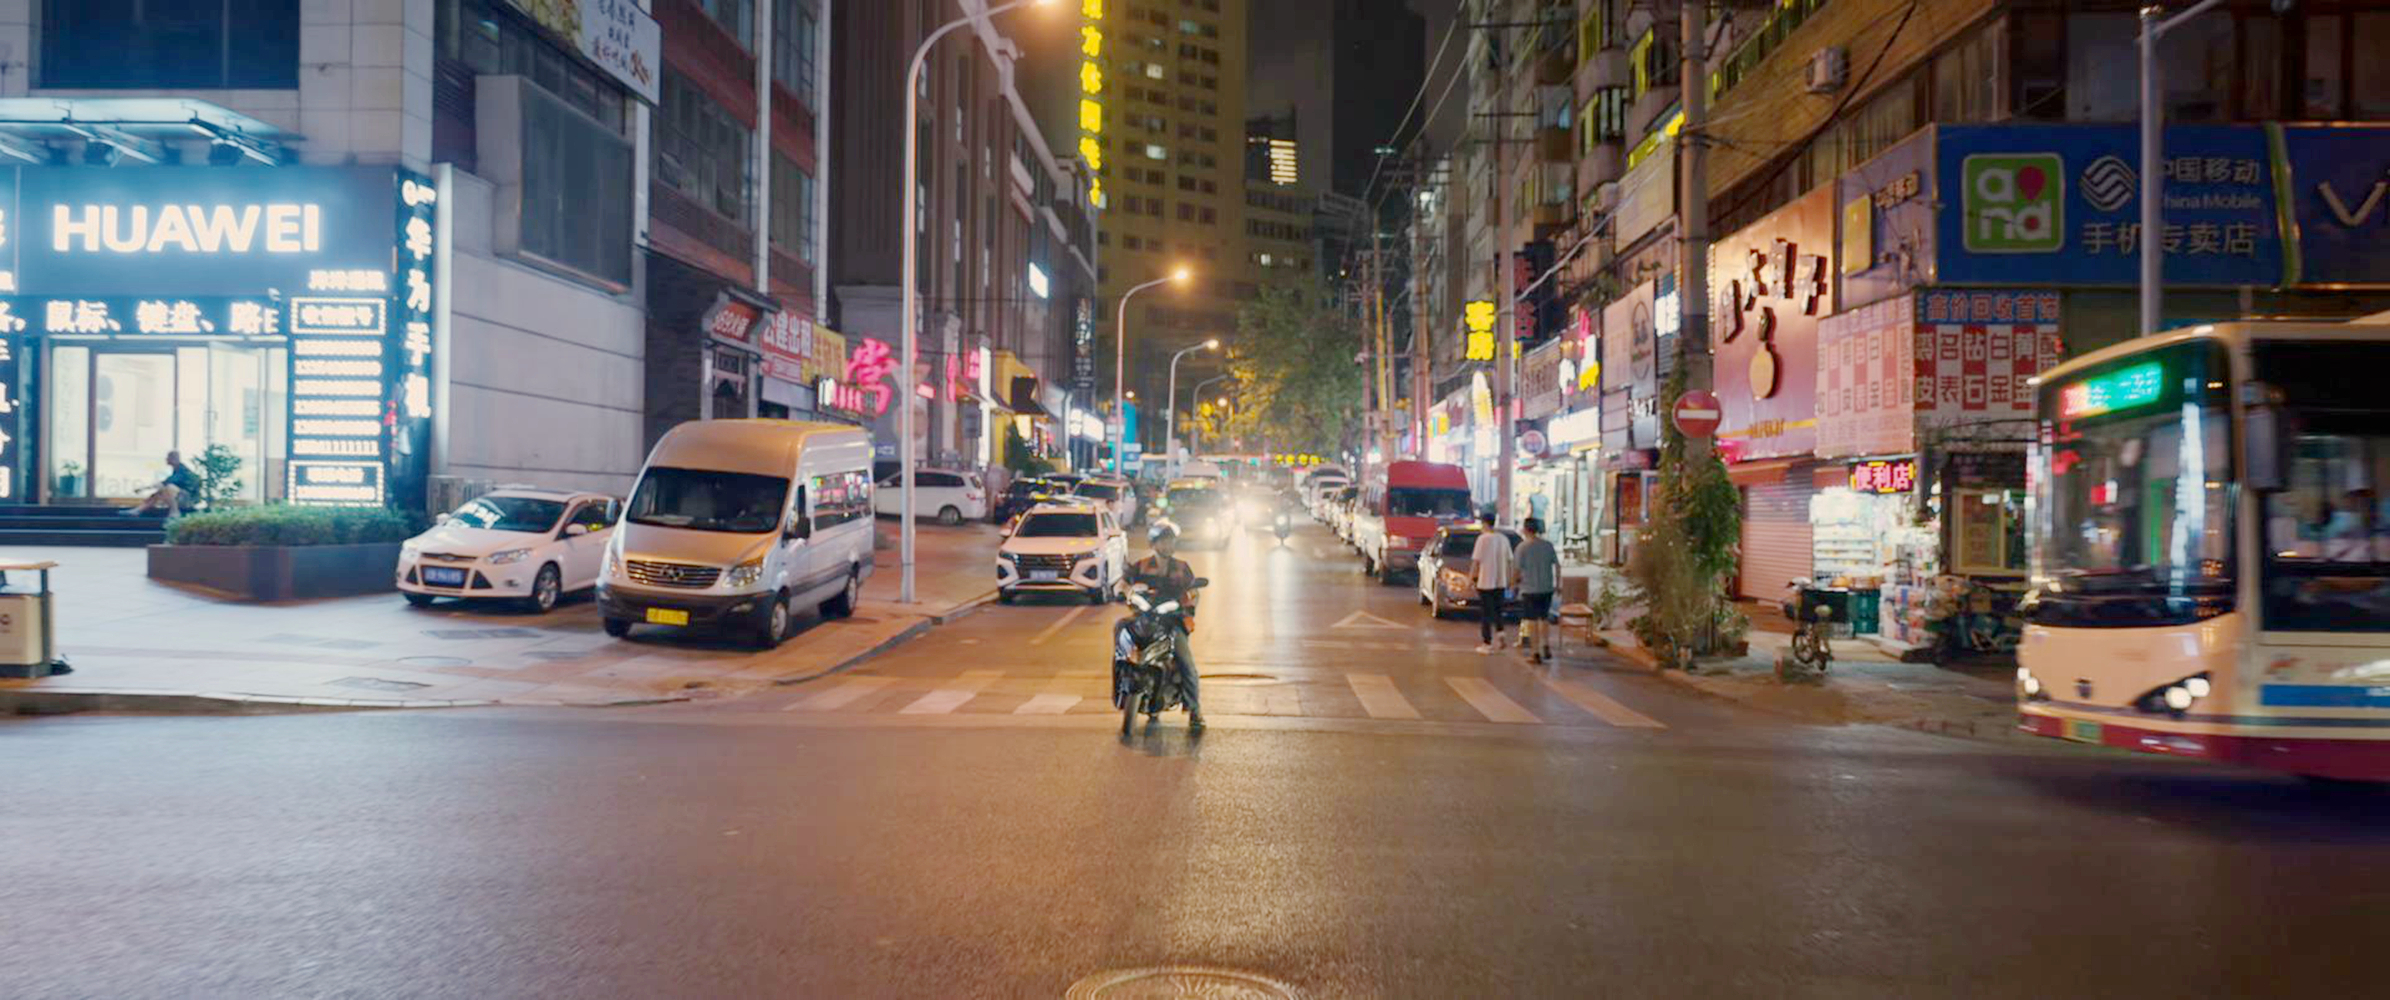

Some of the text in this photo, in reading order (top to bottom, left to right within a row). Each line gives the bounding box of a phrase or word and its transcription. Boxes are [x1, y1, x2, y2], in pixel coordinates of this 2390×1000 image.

[53, 204, 320, 252] HUAWEI
[405, 216, 432, 418] 华为手机
[1854, 463, 1911, 491] 便利店
